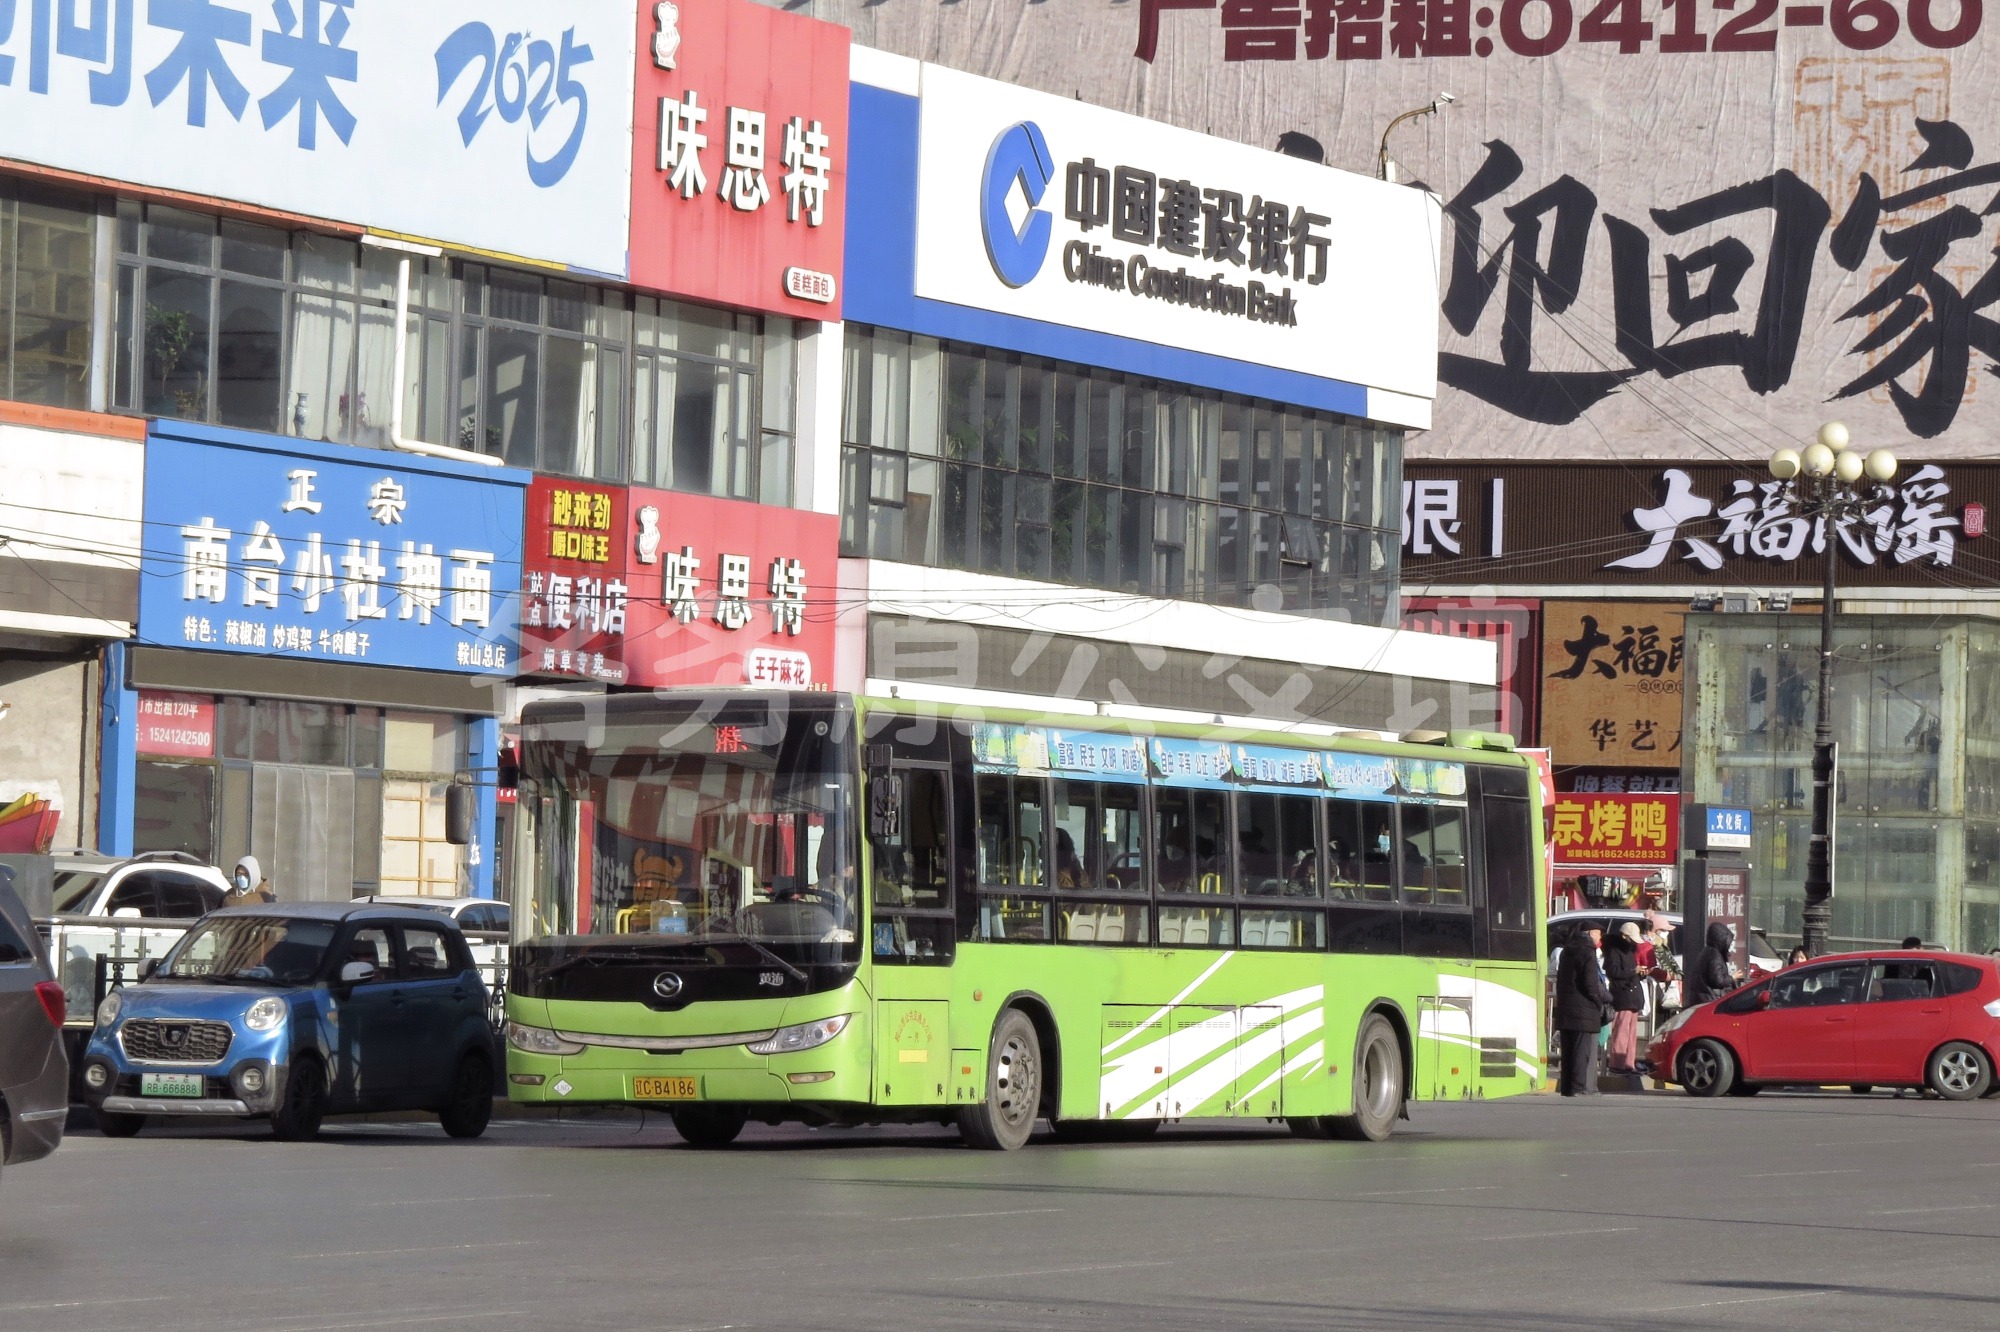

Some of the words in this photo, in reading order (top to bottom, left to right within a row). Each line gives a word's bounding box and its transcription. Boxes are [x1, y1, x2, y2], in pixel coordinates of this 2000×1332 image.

[0, 0, 358, 151] 向未来
[656, 90, 831, 227] 味思特
[1065, 157, 1331, 285] 中国建设银行
[792, 271, 829, 297] 蛋糕面包
[1063, 240, 1125, 292] China
[1127, 254, 1246, 317] Construction
[1247, 280, 1297, 328] Bank
[283, 469, 407, 525] 正宗
[552, 489, 611, 530] 秒来劲
[552, 530, 610, 563] 嚼口味王
[528, 572, 543, 627] 站点
[546, 572, 629, 635] 便利店
[661, 545, 807, 637] 味思特
[225, 619, 266, 648] 辣椒油
[457, 641, 507, 669] 鞍山总店
[543, 648, 605, 676] 烟草专卖
[754, 656, 805, 684] 王子麻花
[1057, 742, 1075, 767] 富强
[1080, 744, 1096, 768] 民主
[1101, 746, 1117, 770] 文明
[1121, 748, 1139, 773] 和谐
[1161, 751, 1175, 774] 自由
[1178, 752, 1192, 775] 平等
[1195, 754, 1209, 777] 公正
[1553, 800, 1667, 847] 京烤鸭
[1716, 812, 1742, 831] 文化街
